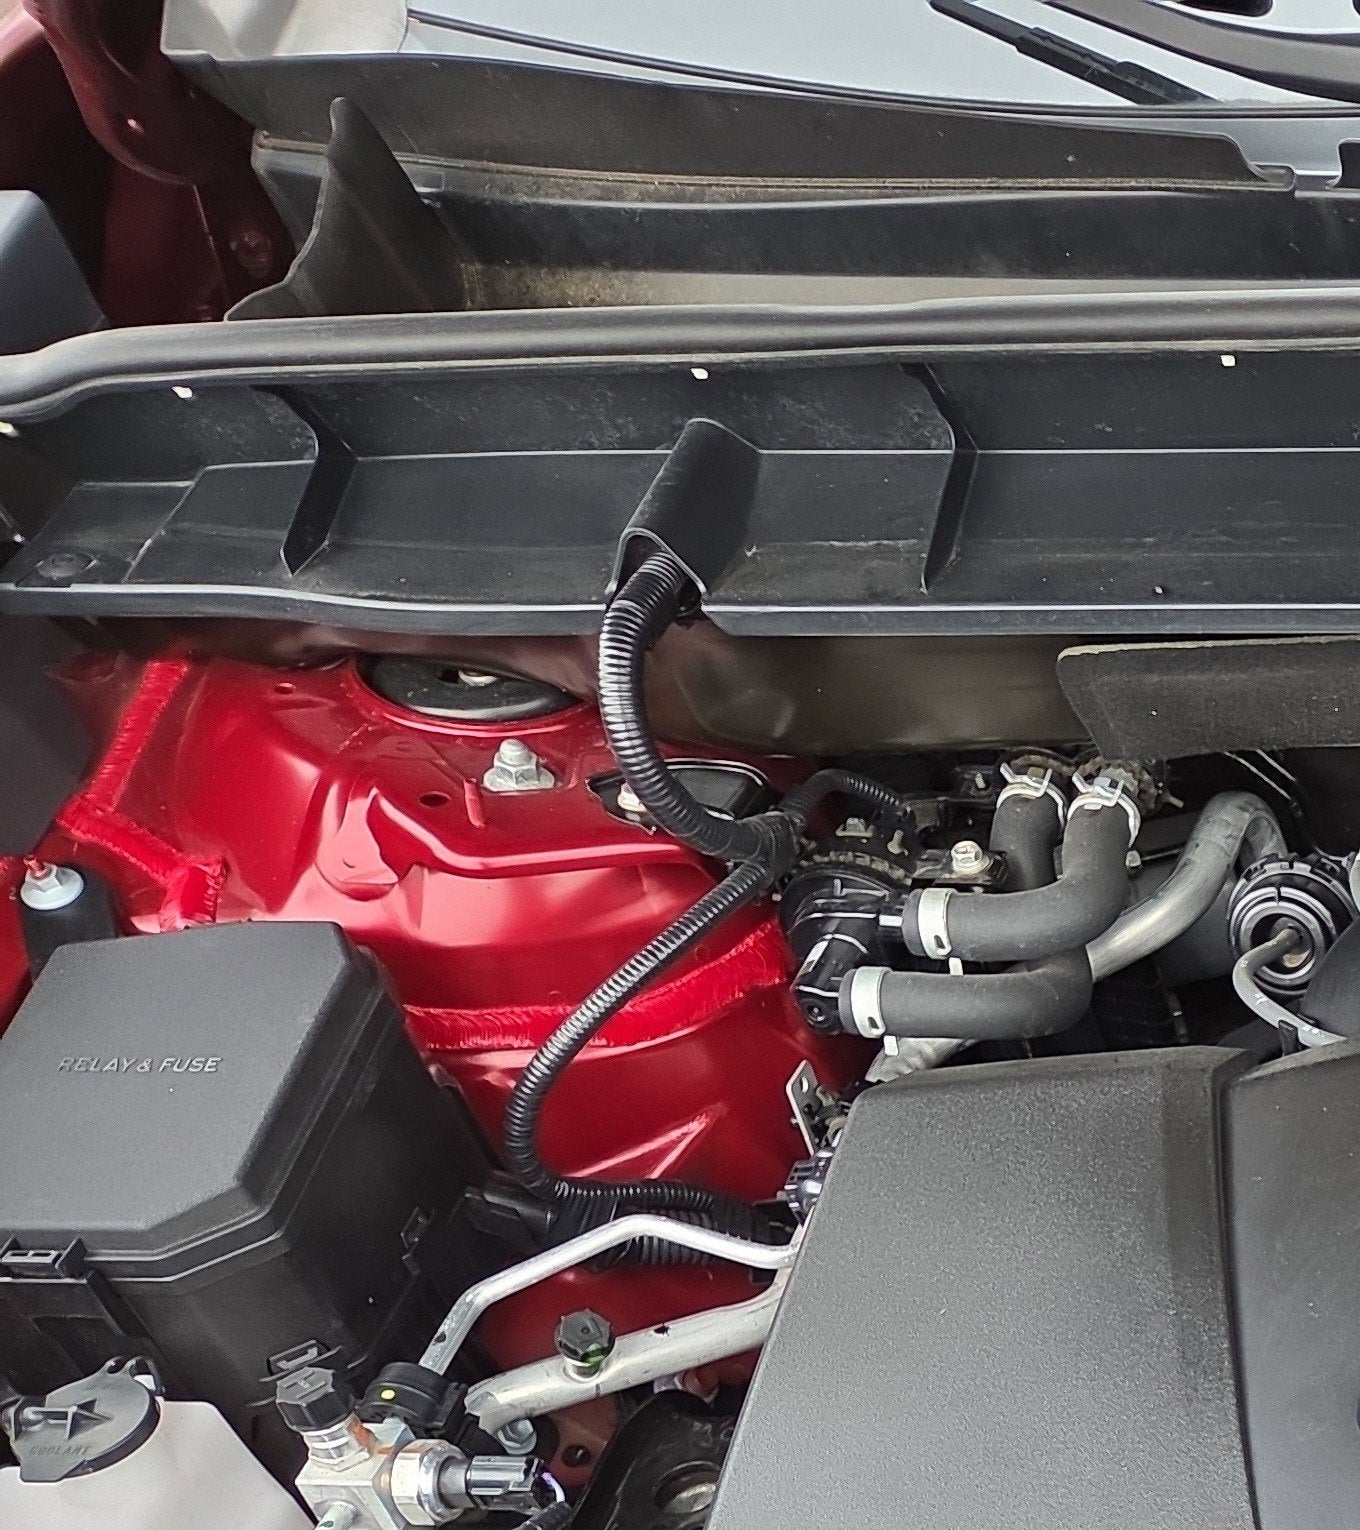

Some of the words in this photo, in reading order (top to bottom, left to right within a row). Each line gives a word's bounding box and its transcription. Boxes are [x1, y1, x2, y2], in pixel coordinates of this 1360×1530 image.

[57, 1057, 134, 1073] RELAY
[136, 1058, 152, 1073] &
[158, 1057, 222, 1073] FUSE
[29, 1445, 89, 1457] COOLANT
